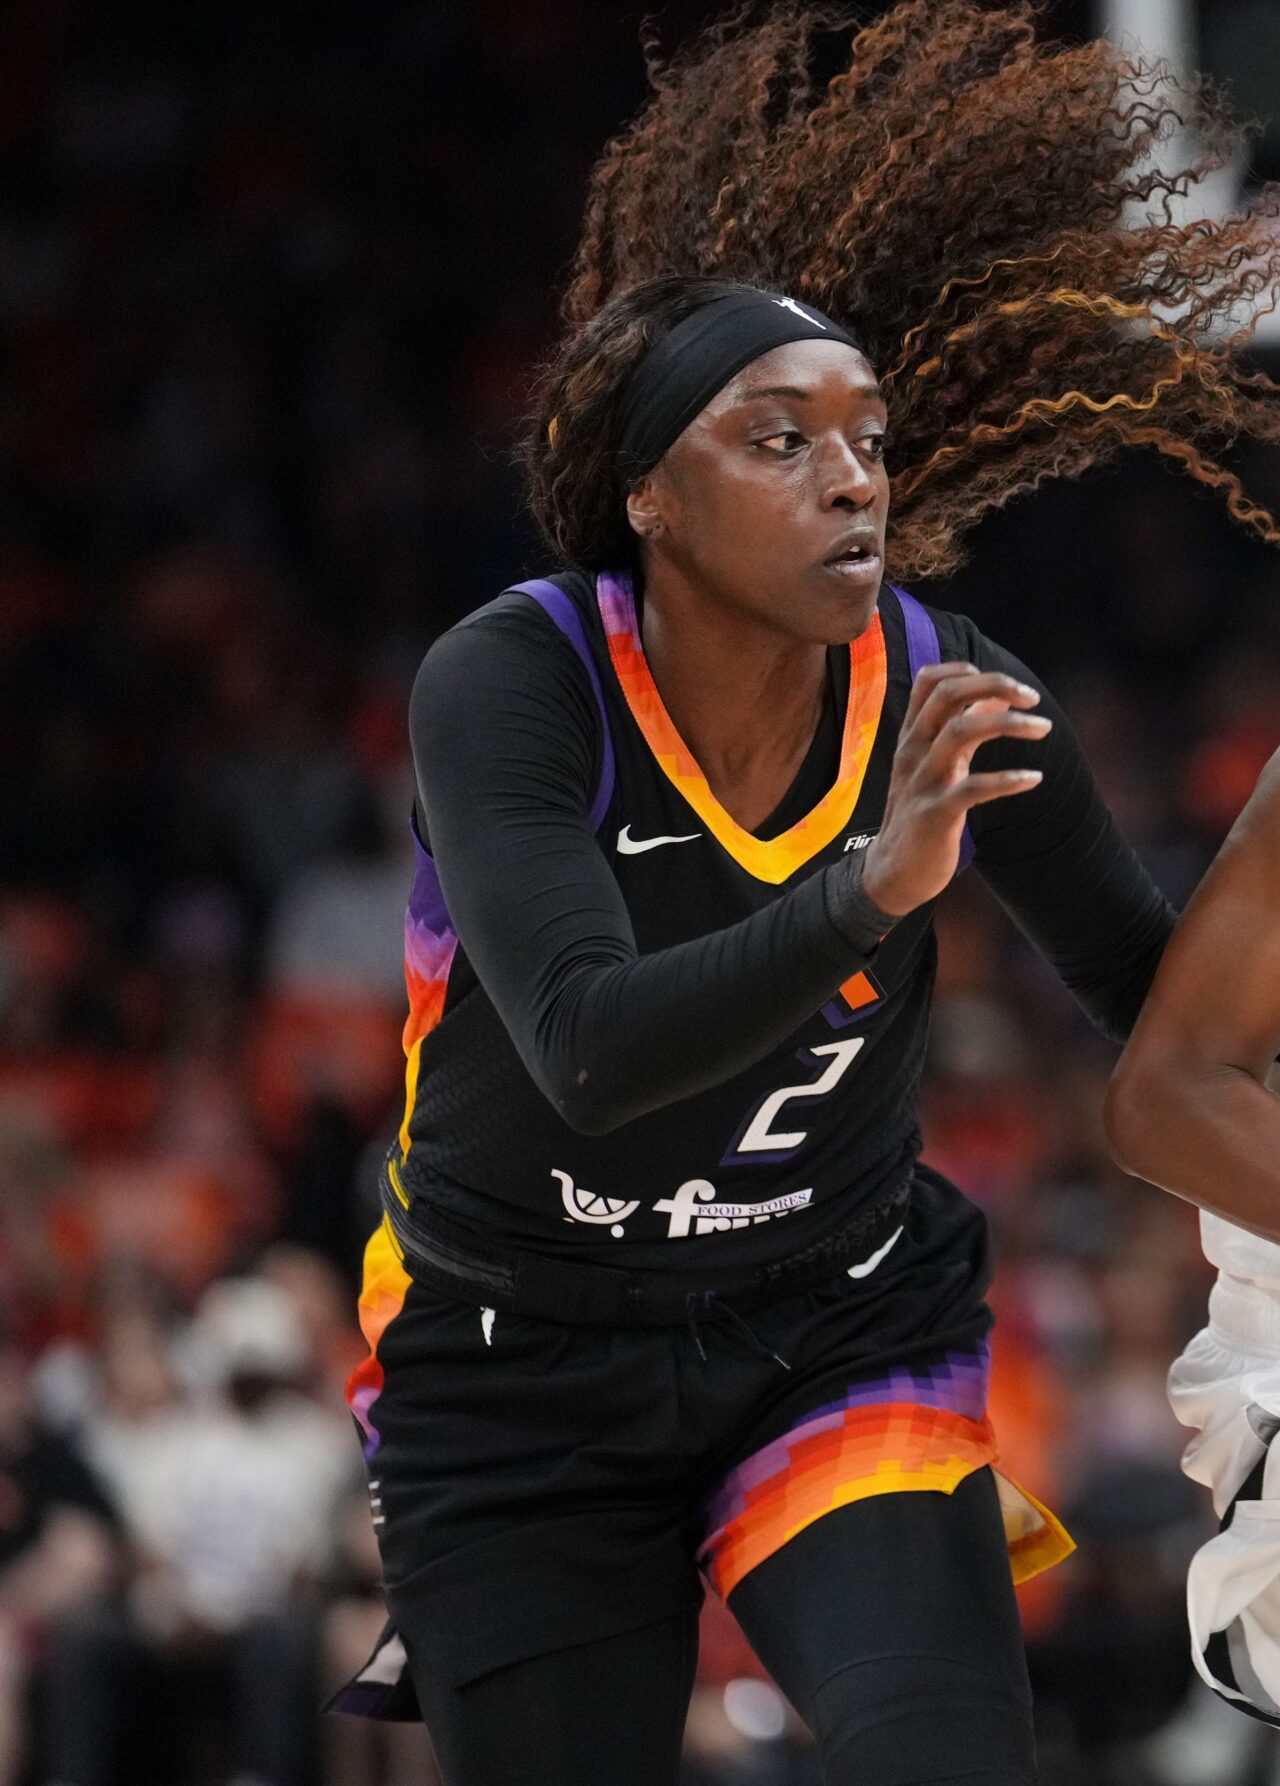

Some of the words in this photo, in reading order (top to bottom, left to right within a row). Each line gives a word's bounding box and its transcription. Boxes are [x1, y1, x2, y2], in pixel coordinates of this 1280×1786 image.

[735, 1037, 865, 1153] 2
[698, 1206, 742, 1216] FOOD
[748, 1193, 807, 1215] STORES
